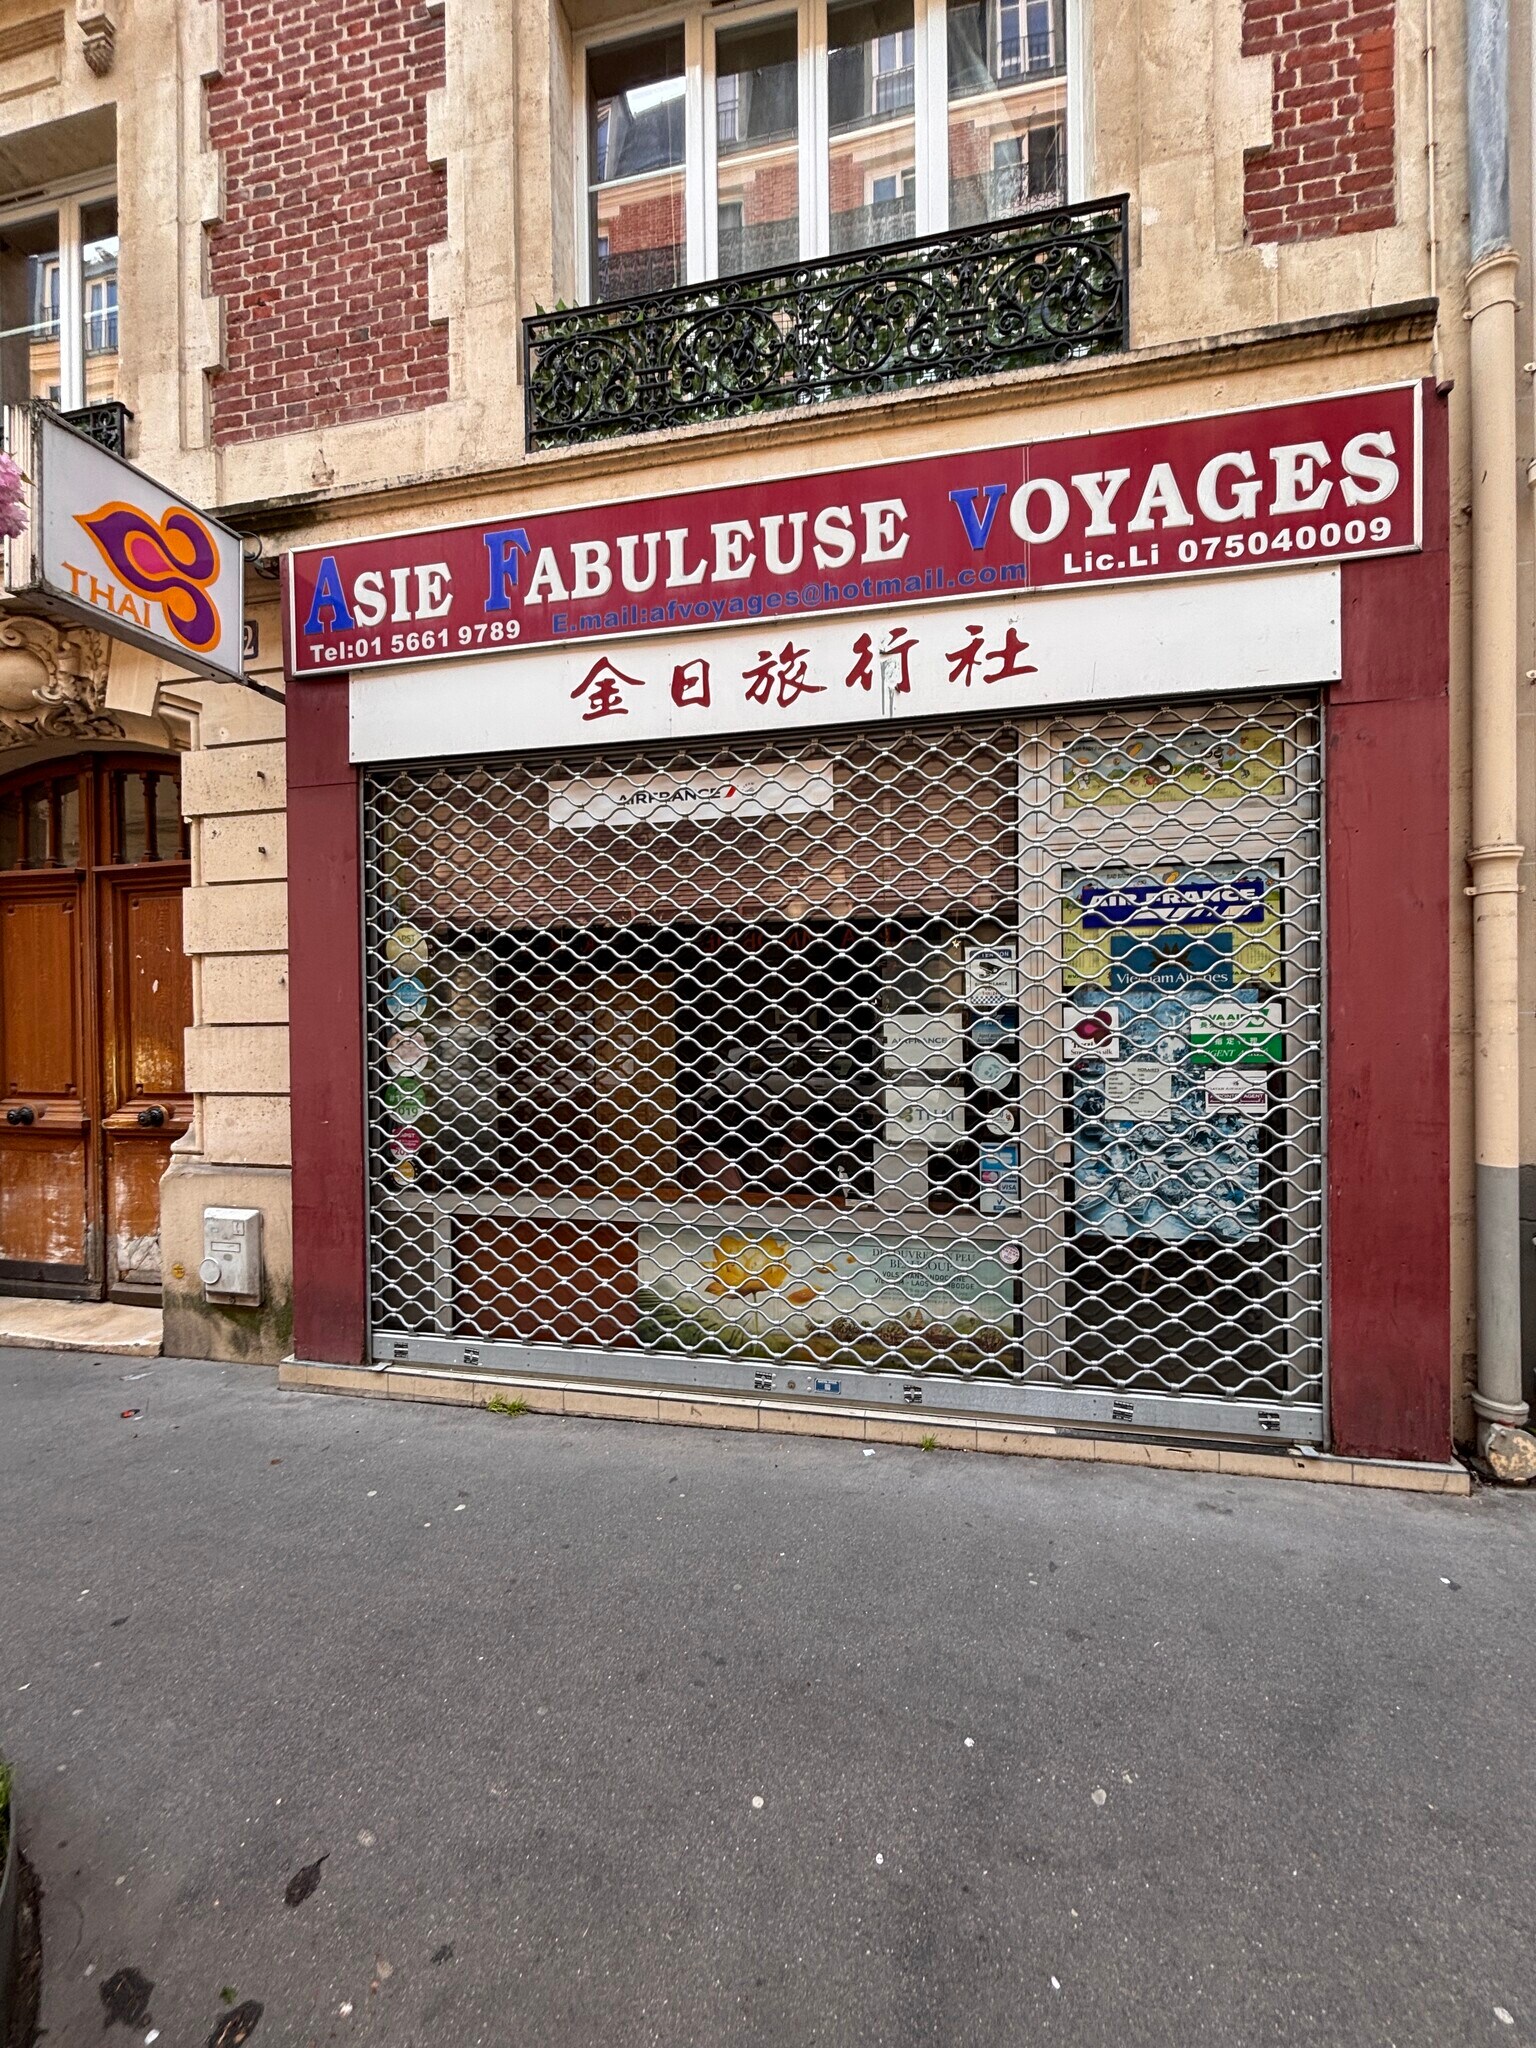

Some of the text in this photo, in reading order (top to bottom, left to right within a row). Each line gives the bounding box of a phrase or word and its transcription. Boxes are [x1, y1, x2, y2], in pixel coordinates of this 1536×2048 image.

[304, 430, 1400, 635] ASIE FABULEUSE VOYAGES
[1063, 516, 1392, 575] Lic.Li 075040009
[61, 561, 151, 629] THAI
[552, 561, 1027, 634] E.mail:afvoyages@hotmail.com
[312, 619, 521, 663] Tel:01 5661 9789
[1089, 888, 1256, 908] AIR FRANCE
[1116, 973, 1174, 985] Vieam
[1201, 1013, 1226, 1021] VA
[395, 1107, 418, 1118] 019
